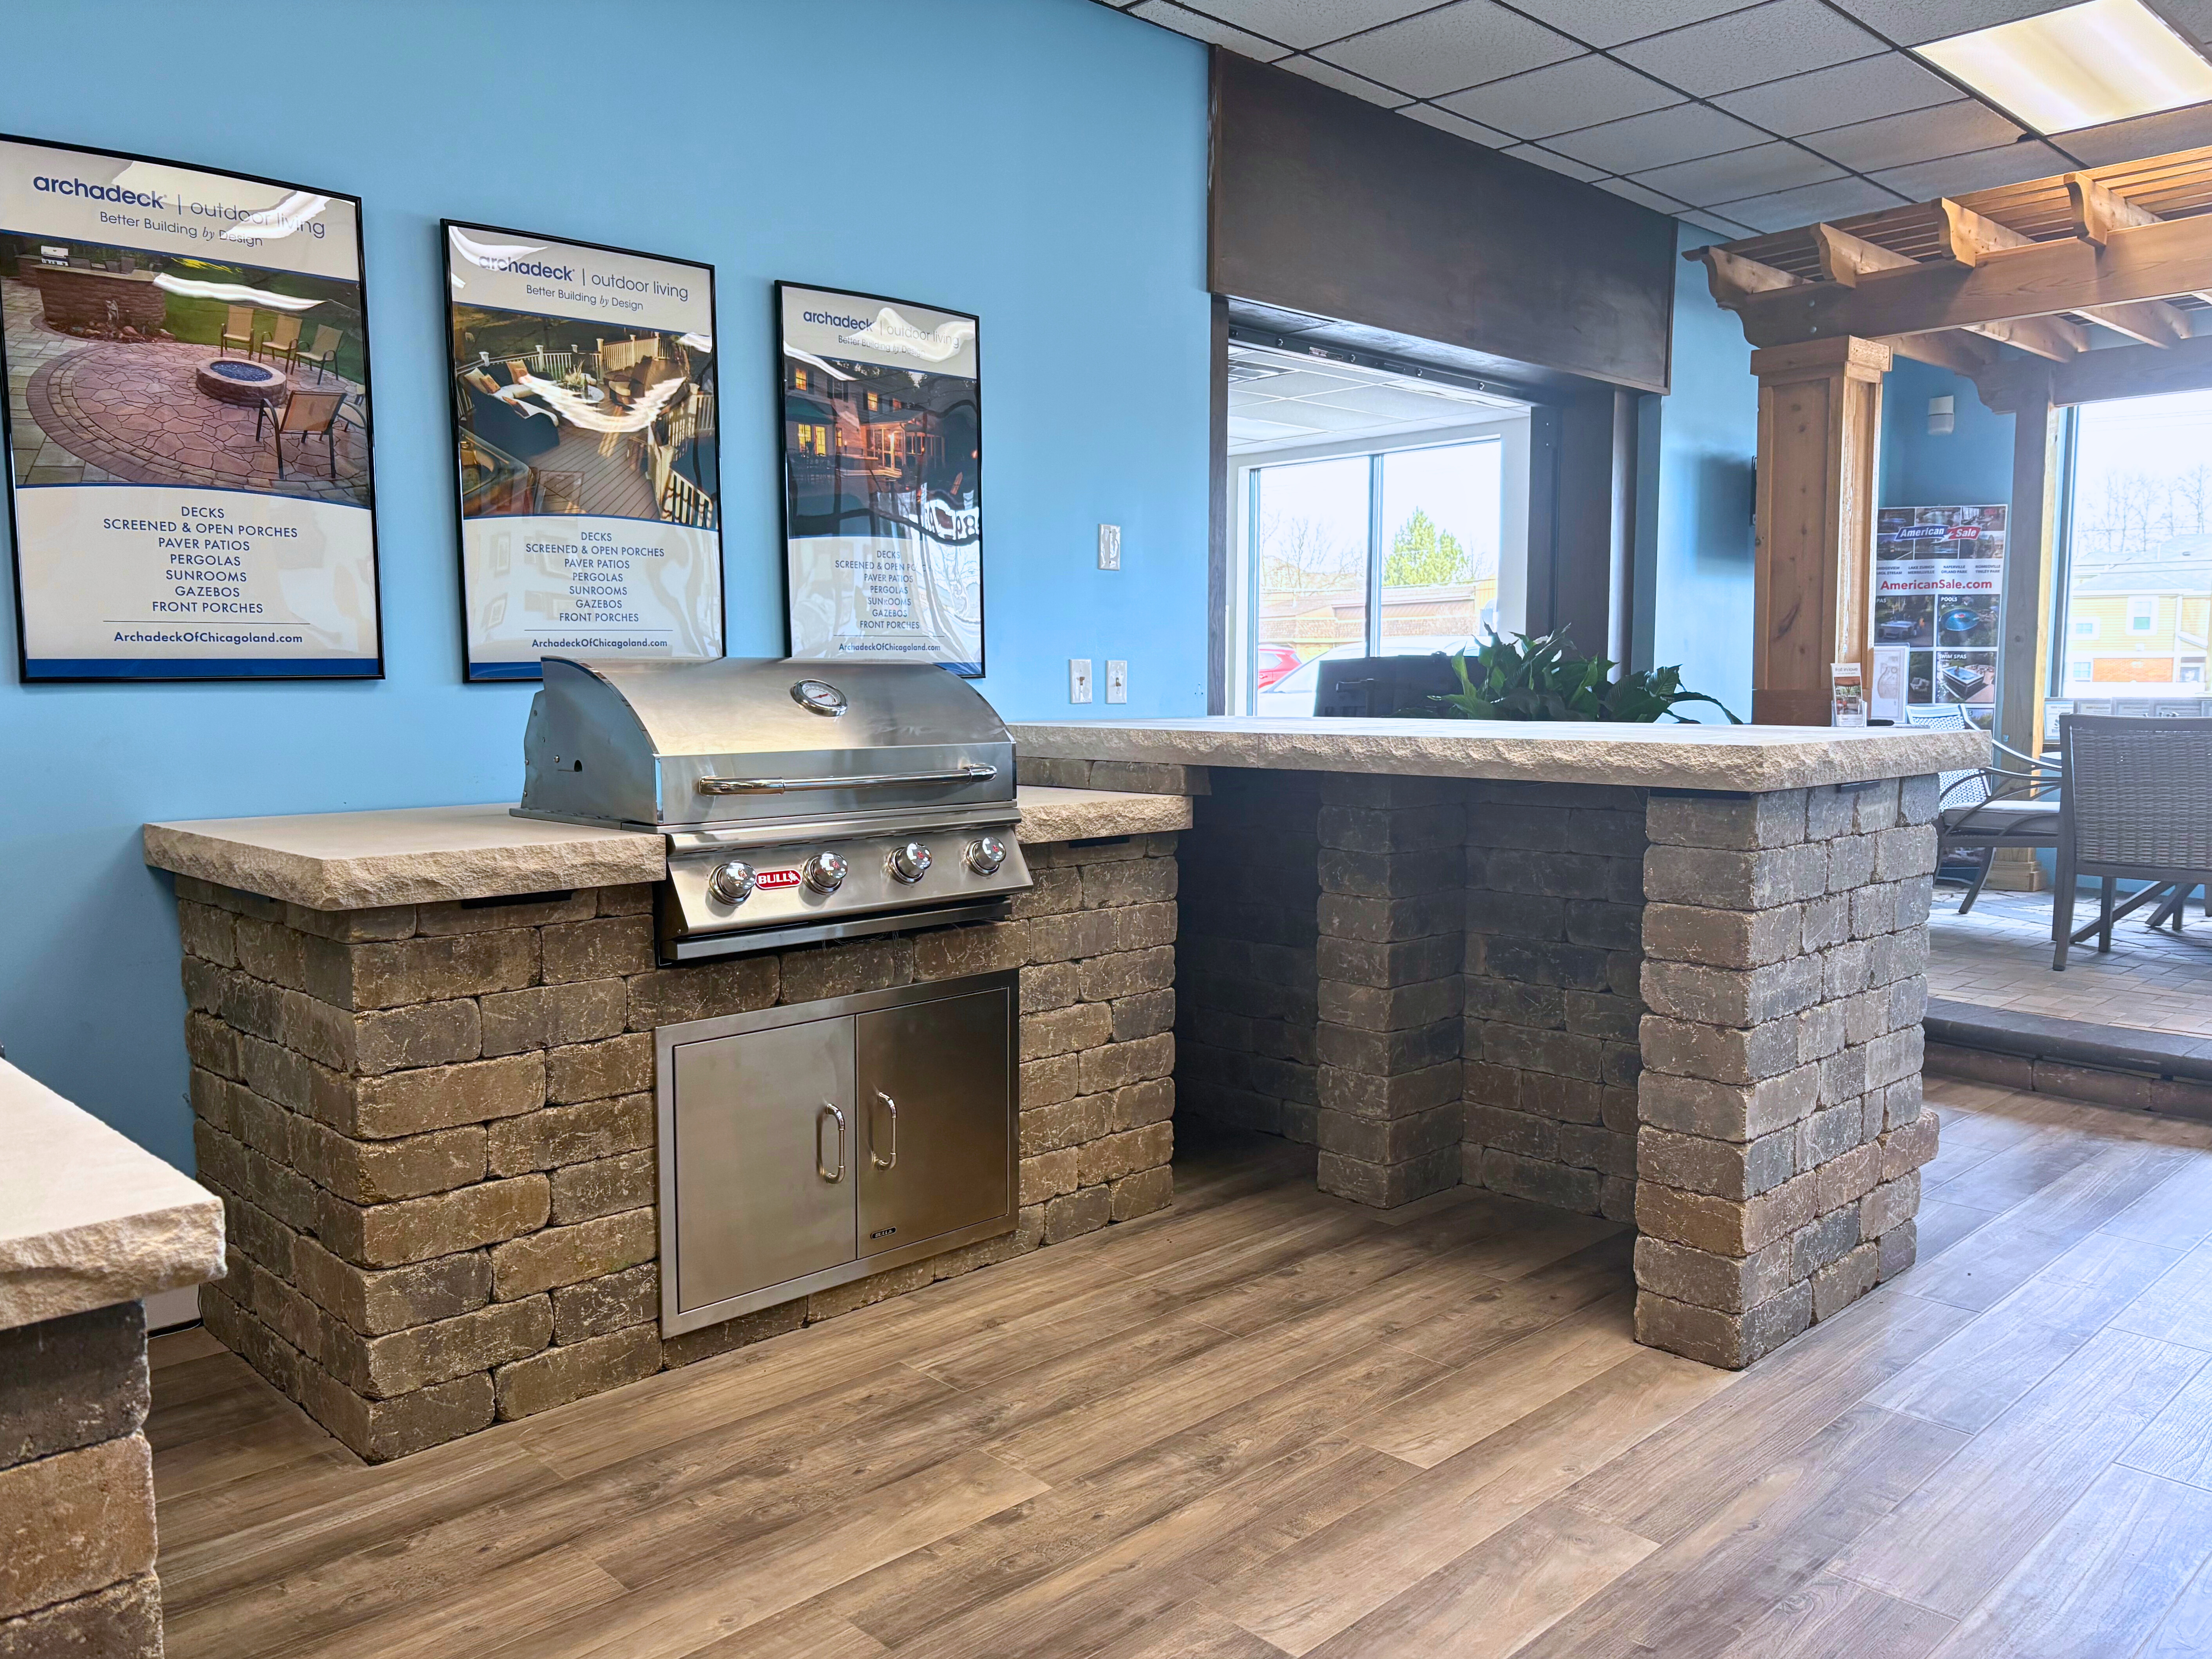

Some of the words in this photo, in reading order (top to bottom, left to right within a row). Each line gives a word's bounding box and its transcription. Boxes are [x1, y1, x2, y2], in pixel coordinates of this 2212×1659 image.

[33, 176, 164, 209] archadeck
[190, 202, 271, 225] outdoor
[277, 212, 324, 238] living
[100, 211, 139, 227] Better
[145, 218, 197, 238] Building
[203, 227, 215, 241] by
[219, 230, 262, 247] Design
[479, 255, 573, 282] archadeck
[592, 273, 649, 293] outdoor
[653, 281, 688, 301] living
[527, 284, 555, 297] Better
[558, 289, 596, 305] Building
[600, 295, 609, 308] by
[612, 298, 643, 311] Design
[803, 311, 873, 332] archadeck
[887, 324, 930, 341] outdoor
[933, 330, 959, 348] living
[838, 335, 860, 346] Better
[862, 339, 890, 352] Building
[902, 346, 925, 357] Design
[181, 506, 224, 518] DECKS
[103, 518, 177, 532] SCREENED
[182, 522, 192, 533] &
[196, 523, 233, 535] OPEN
[239, 525, 298, 538] PORCHES
[1900, 528, 1944, 537] American
[1956, 529, 1976, 537] Sale
[581, 532, 612, 542] DECKS
[159, 537, 199, 549] PAVER
[205, 539, 250, 551] PATIOS
[526, 543, 578, 554] SCREENED
[582, 546, 588, 554] &
[591, 546, 618, 555] OPEN
[622, 547, 664, 557] PORCHES
[877, 551, 900, 559] DECKS
[170, 554, 241, 566] PERGOLAS
[565, 559, 594, 568] PAVER
[597, 560, 630, 569] PATIOS
[835, 560, 874, 570] SCREENED
[884, 562, 905, 571] OPEN
[166, 570, 247, 582] SUNROOMS
[573, 572, 623, 582] PERGOLAS
[864, 574, 886, 582] PAVER
[889, 575, 913, 583] PATIOS
[870, 586, 908, 594] PERGOLAS
[1881, 579, 1992, 590] AmericanSale.com
[175, 586, 239, 597] GAZEBOS
[569, 586, 627, 596] SUNROOMS
[152, 601, 197, 612] FRONT
[203, 602, 263, 613] PORCHES
[576, 599, 622, 609] GAZEBOS
[868, 598, 911, 606] SUNROOMS
[559, 613, 592, 622] FRONT
[595, 613, 639, 622] PORCHES
[872, 609, 907, 618] GAZEBOS
[114, 631, 302, 645] ArchadeckOfChicagoland.com
[532, 638, 667, 649] ArchadeckOfChicagoland.com
[839, 643, 941, 652] ArchadeckOfChicagoland.com
[758, 873, 790, 884] BULL
